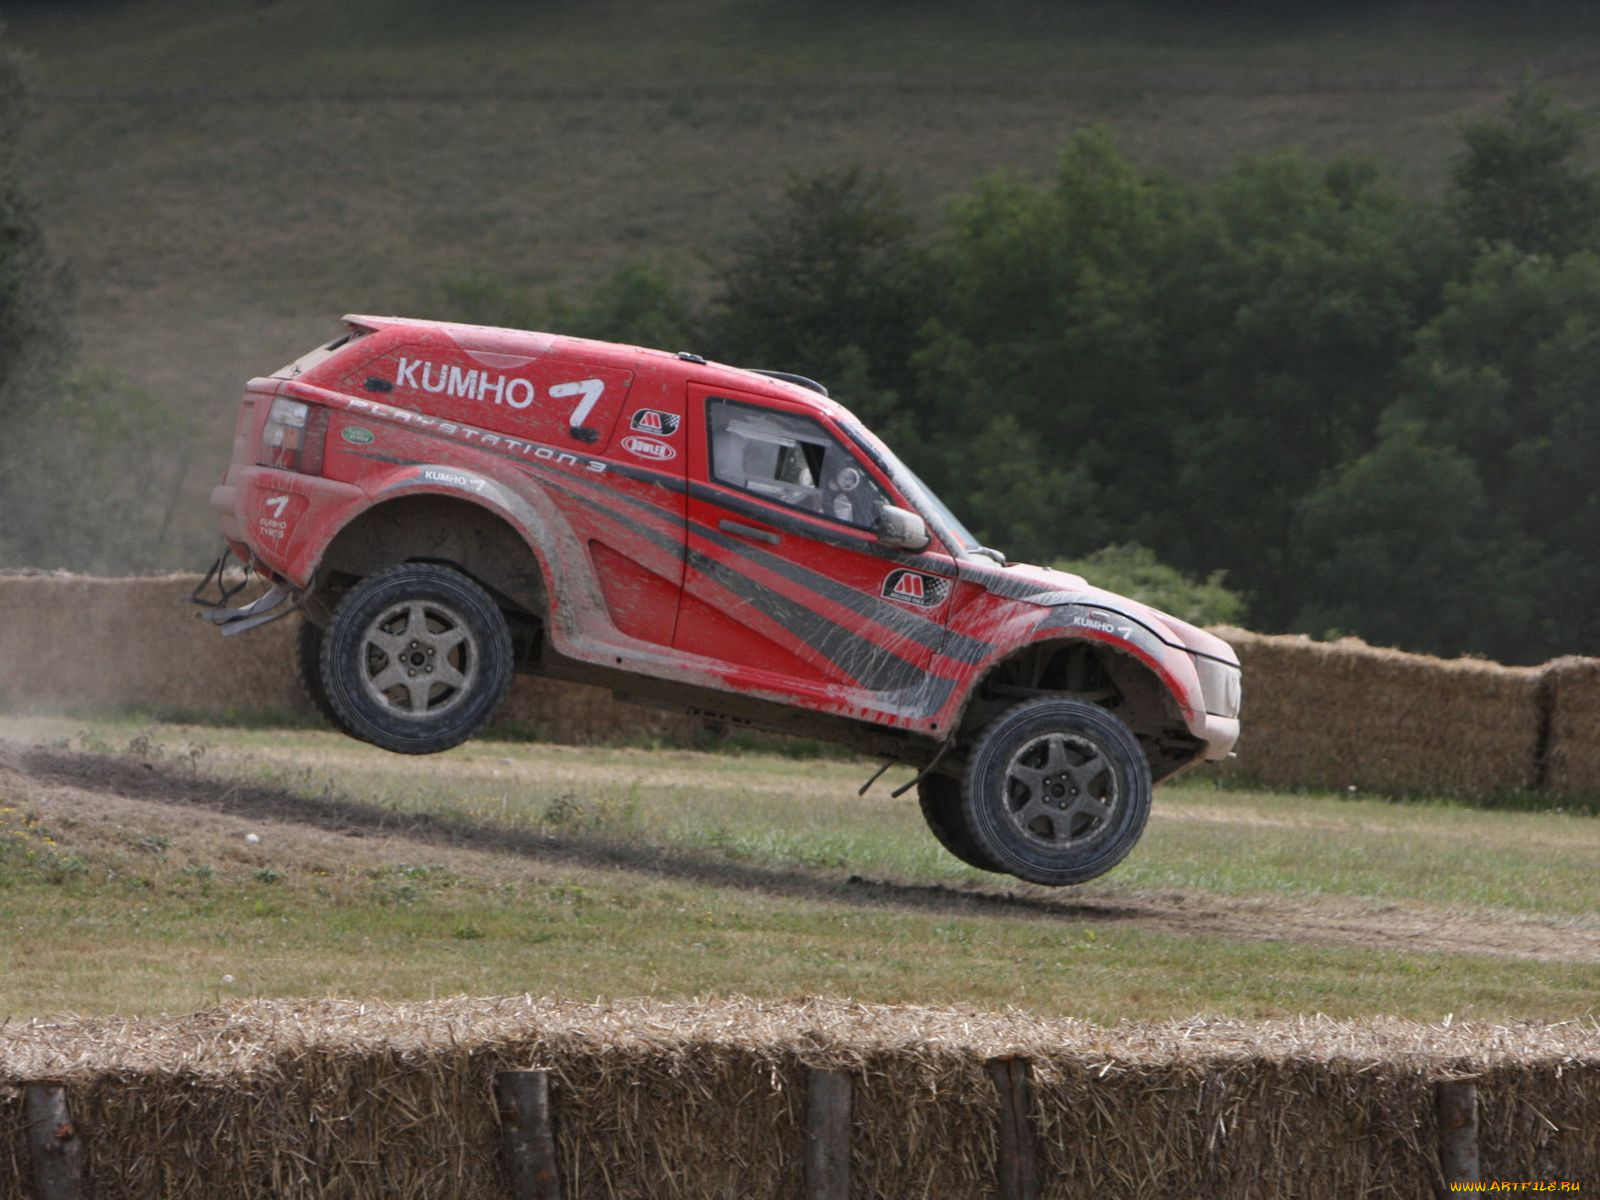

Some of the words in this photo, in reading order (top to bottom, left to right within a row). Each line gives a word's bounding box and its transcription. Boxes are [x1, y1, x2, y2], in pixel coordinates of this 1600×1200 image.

[396, 357, 534, 409] KUMHO
[586, 460, 607, 473] 3
[425, 470, 466, 485] KUMHO
[1073, 616, 1114, 633] KUMHO
